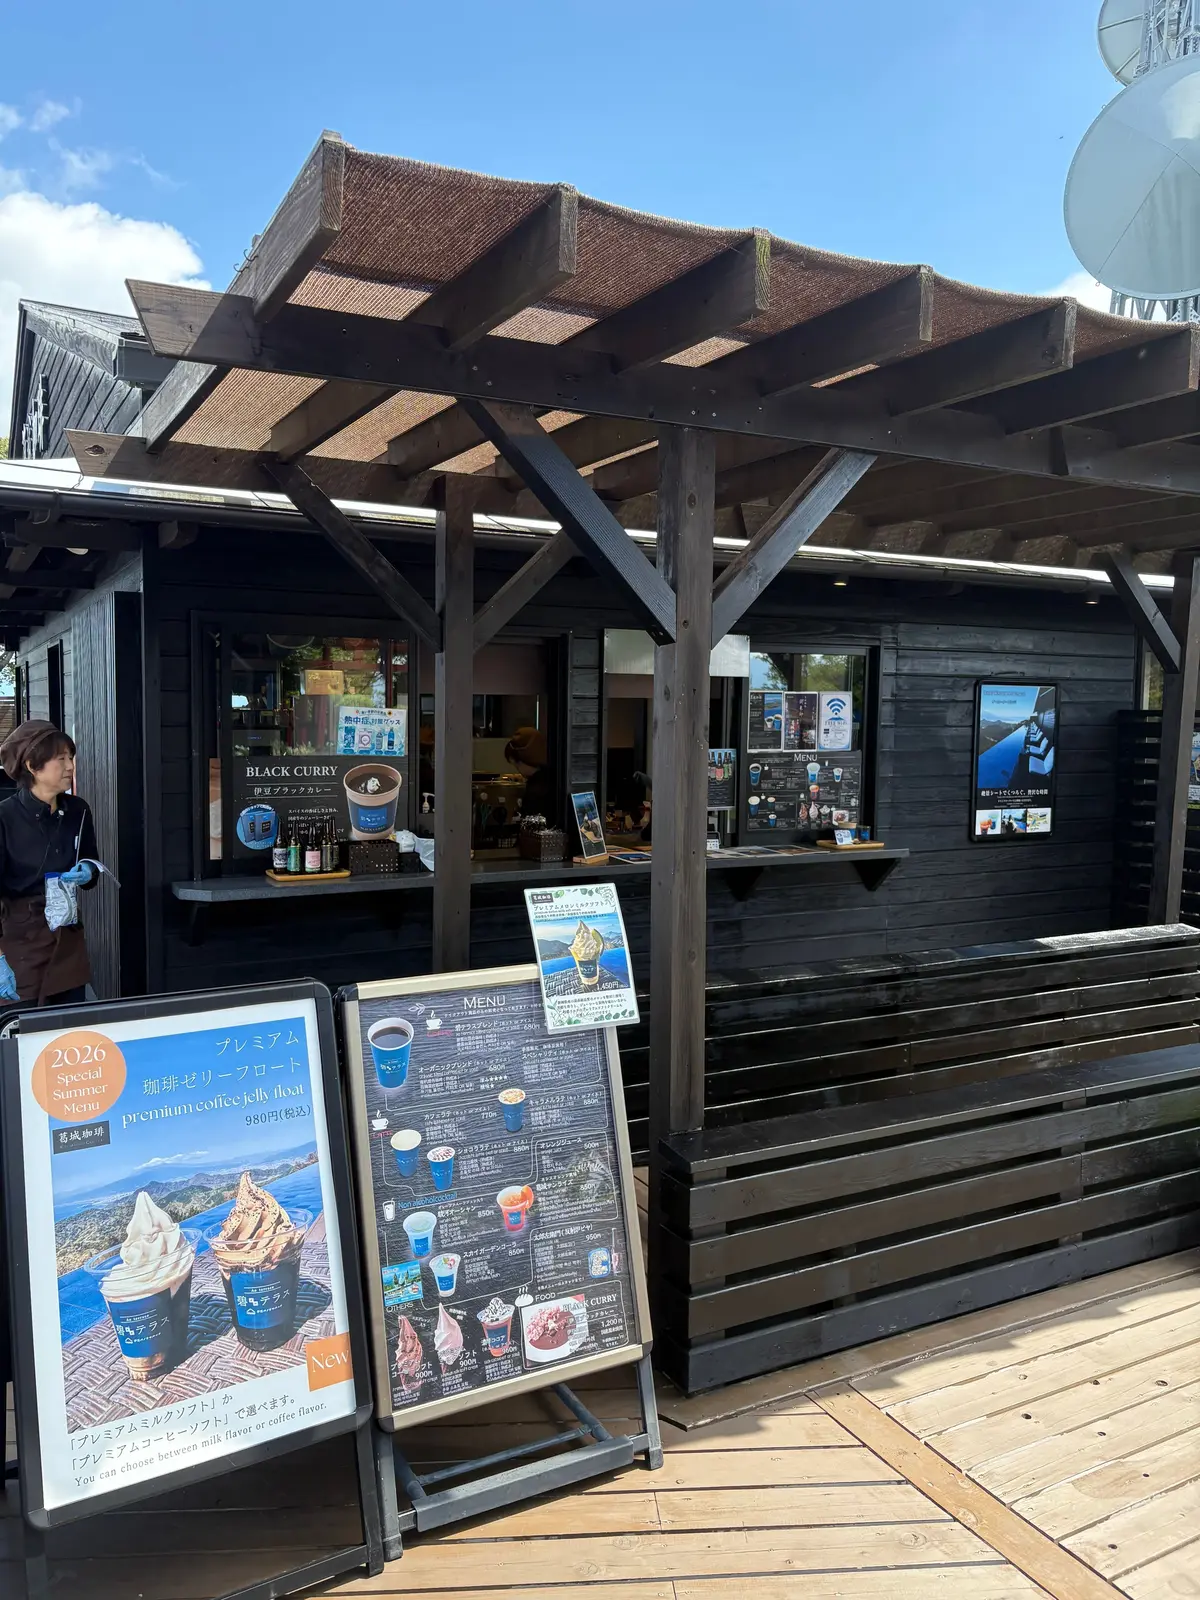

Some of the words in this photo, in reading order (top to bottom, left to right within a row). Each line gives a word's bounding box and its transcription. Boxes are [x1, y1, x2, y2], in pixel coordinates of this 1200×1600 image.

[794, 754, 818, 762] MENU
[246, 766, 291, 778] BLACK
[293, 765, 339, 778] CURRY
[254, 786, 332, 796] 伊豆ブラックカレー
[464, 995, 506, 1010] MENU
[216, 1030, 300, 1056] プレミアム
[51, 1042, 106, 1068] 2026
[57, 1068, 102, 1085] Special
[142, 1058, 302, 1096] 珈琲ゼリーフロート
[52, 1083, 108, 1102] Summer
[64, 1101, 100, 1116] Menu
[122, 1102, 193, 1129] premium
[196, 1092, 240, 1116] coffee
[240, 1087, 272, 1110] jelly
[272, 1084, 305, 1099] float
[244, 1106, 312, 1128] 980円(税込)
[424, 1110, 451, 1120] カフェラテ
[58, 1126, 104, 1144] 葛城珈琲
[540, 1137, 582, 1149] オレンジジュース
[463, 1241, 517, 1258] スカイガーデンコーラ
[535, 1292, 556, 1301] FOOD
[590, 1294, 617, 1306] CURRY
[386, 1303, 414, 1312] OTHERS
[601, 1318, 622, 1328] 1,200円
[310, 1350, 349, 1374] New
[459, 1358, 477, 1368] 900円
[415, 1370, 433, 1379] 900円
[70, 1392, 234, 1450] 「プレミアムミルクソフト」か
[71, 1394, 296, 1472] 「プレミアムコーヒーソフト」で選べます。
[74, 1471, 96, 1488] You
[99, 1468, 118, 1480] can
[120, 1457, 156, 1476] choose
[158, 1442, 198, 1463] between
[202, 1434, 222, 1451] milk
[225, 1426, 253, 1444] flavor
[255, 1424, 266, 1434] or
[268, 1412, 297, 1430] coffee
[299, 1404, 328, 1422] flavor.
